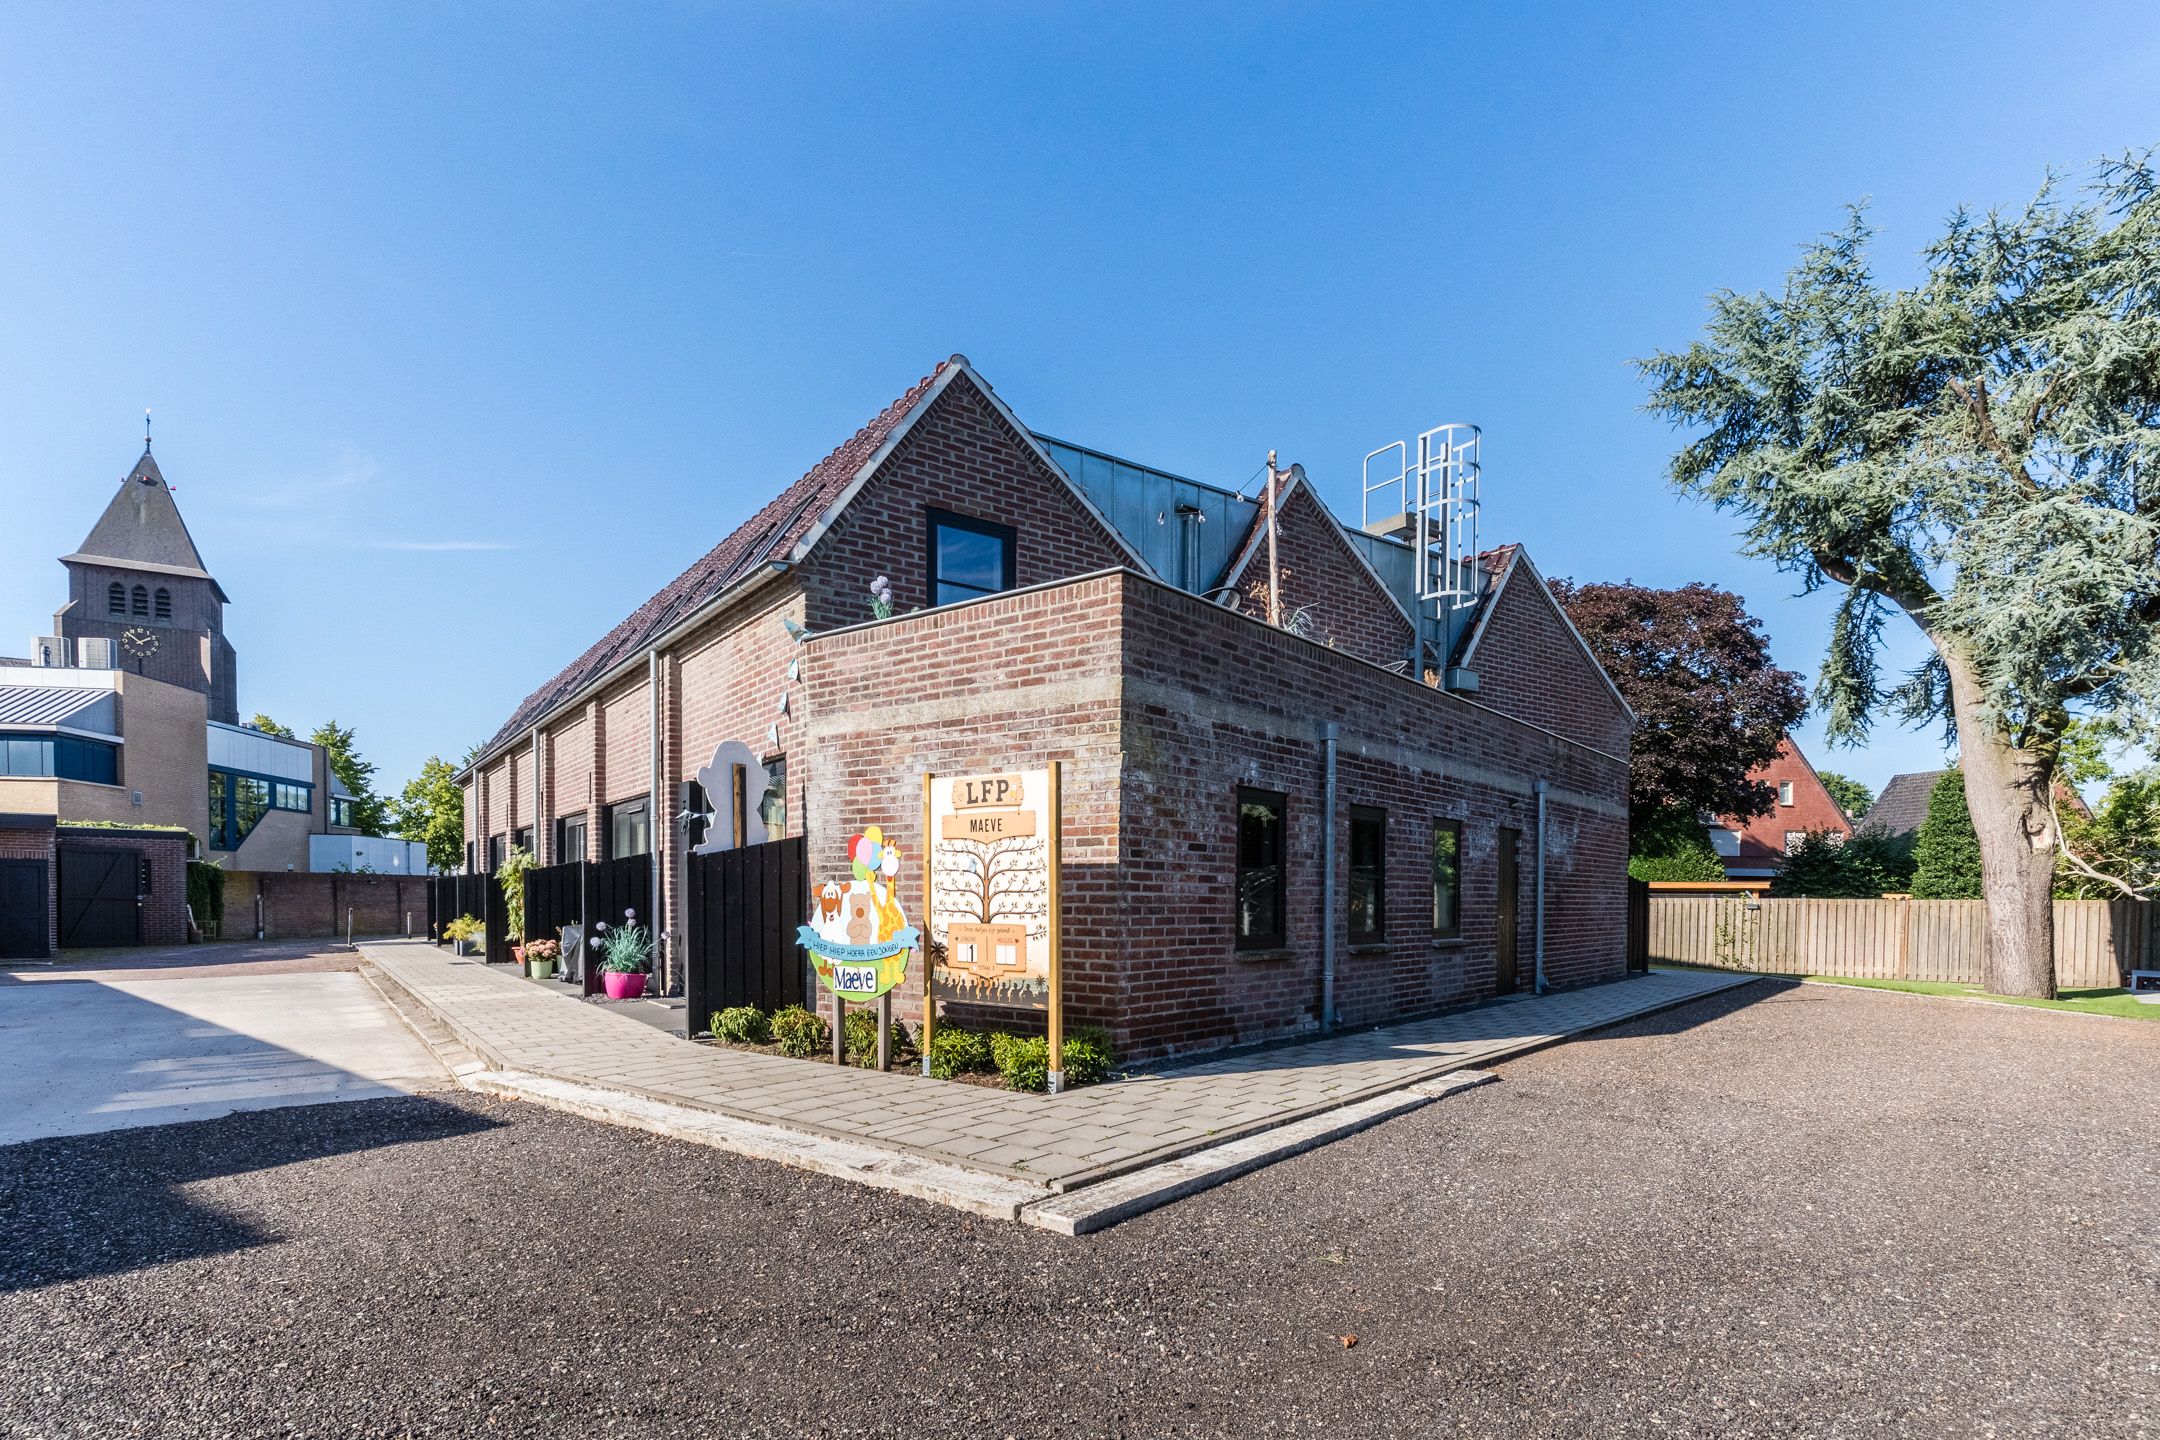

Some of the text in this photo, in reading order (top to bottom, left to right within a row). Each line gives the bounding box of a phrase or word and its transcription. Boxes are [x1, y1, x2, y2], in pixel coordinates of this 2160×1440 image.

[966, 780, 1009, 804] LFP
[970, 818, 1002, 832] MAEVE
[813, 942, 828, 951] HIEP
[830, 946, 845, 955] HIEP
[970, 945, 974, 961] 1
[835, 968, 873, 990] Maeve
